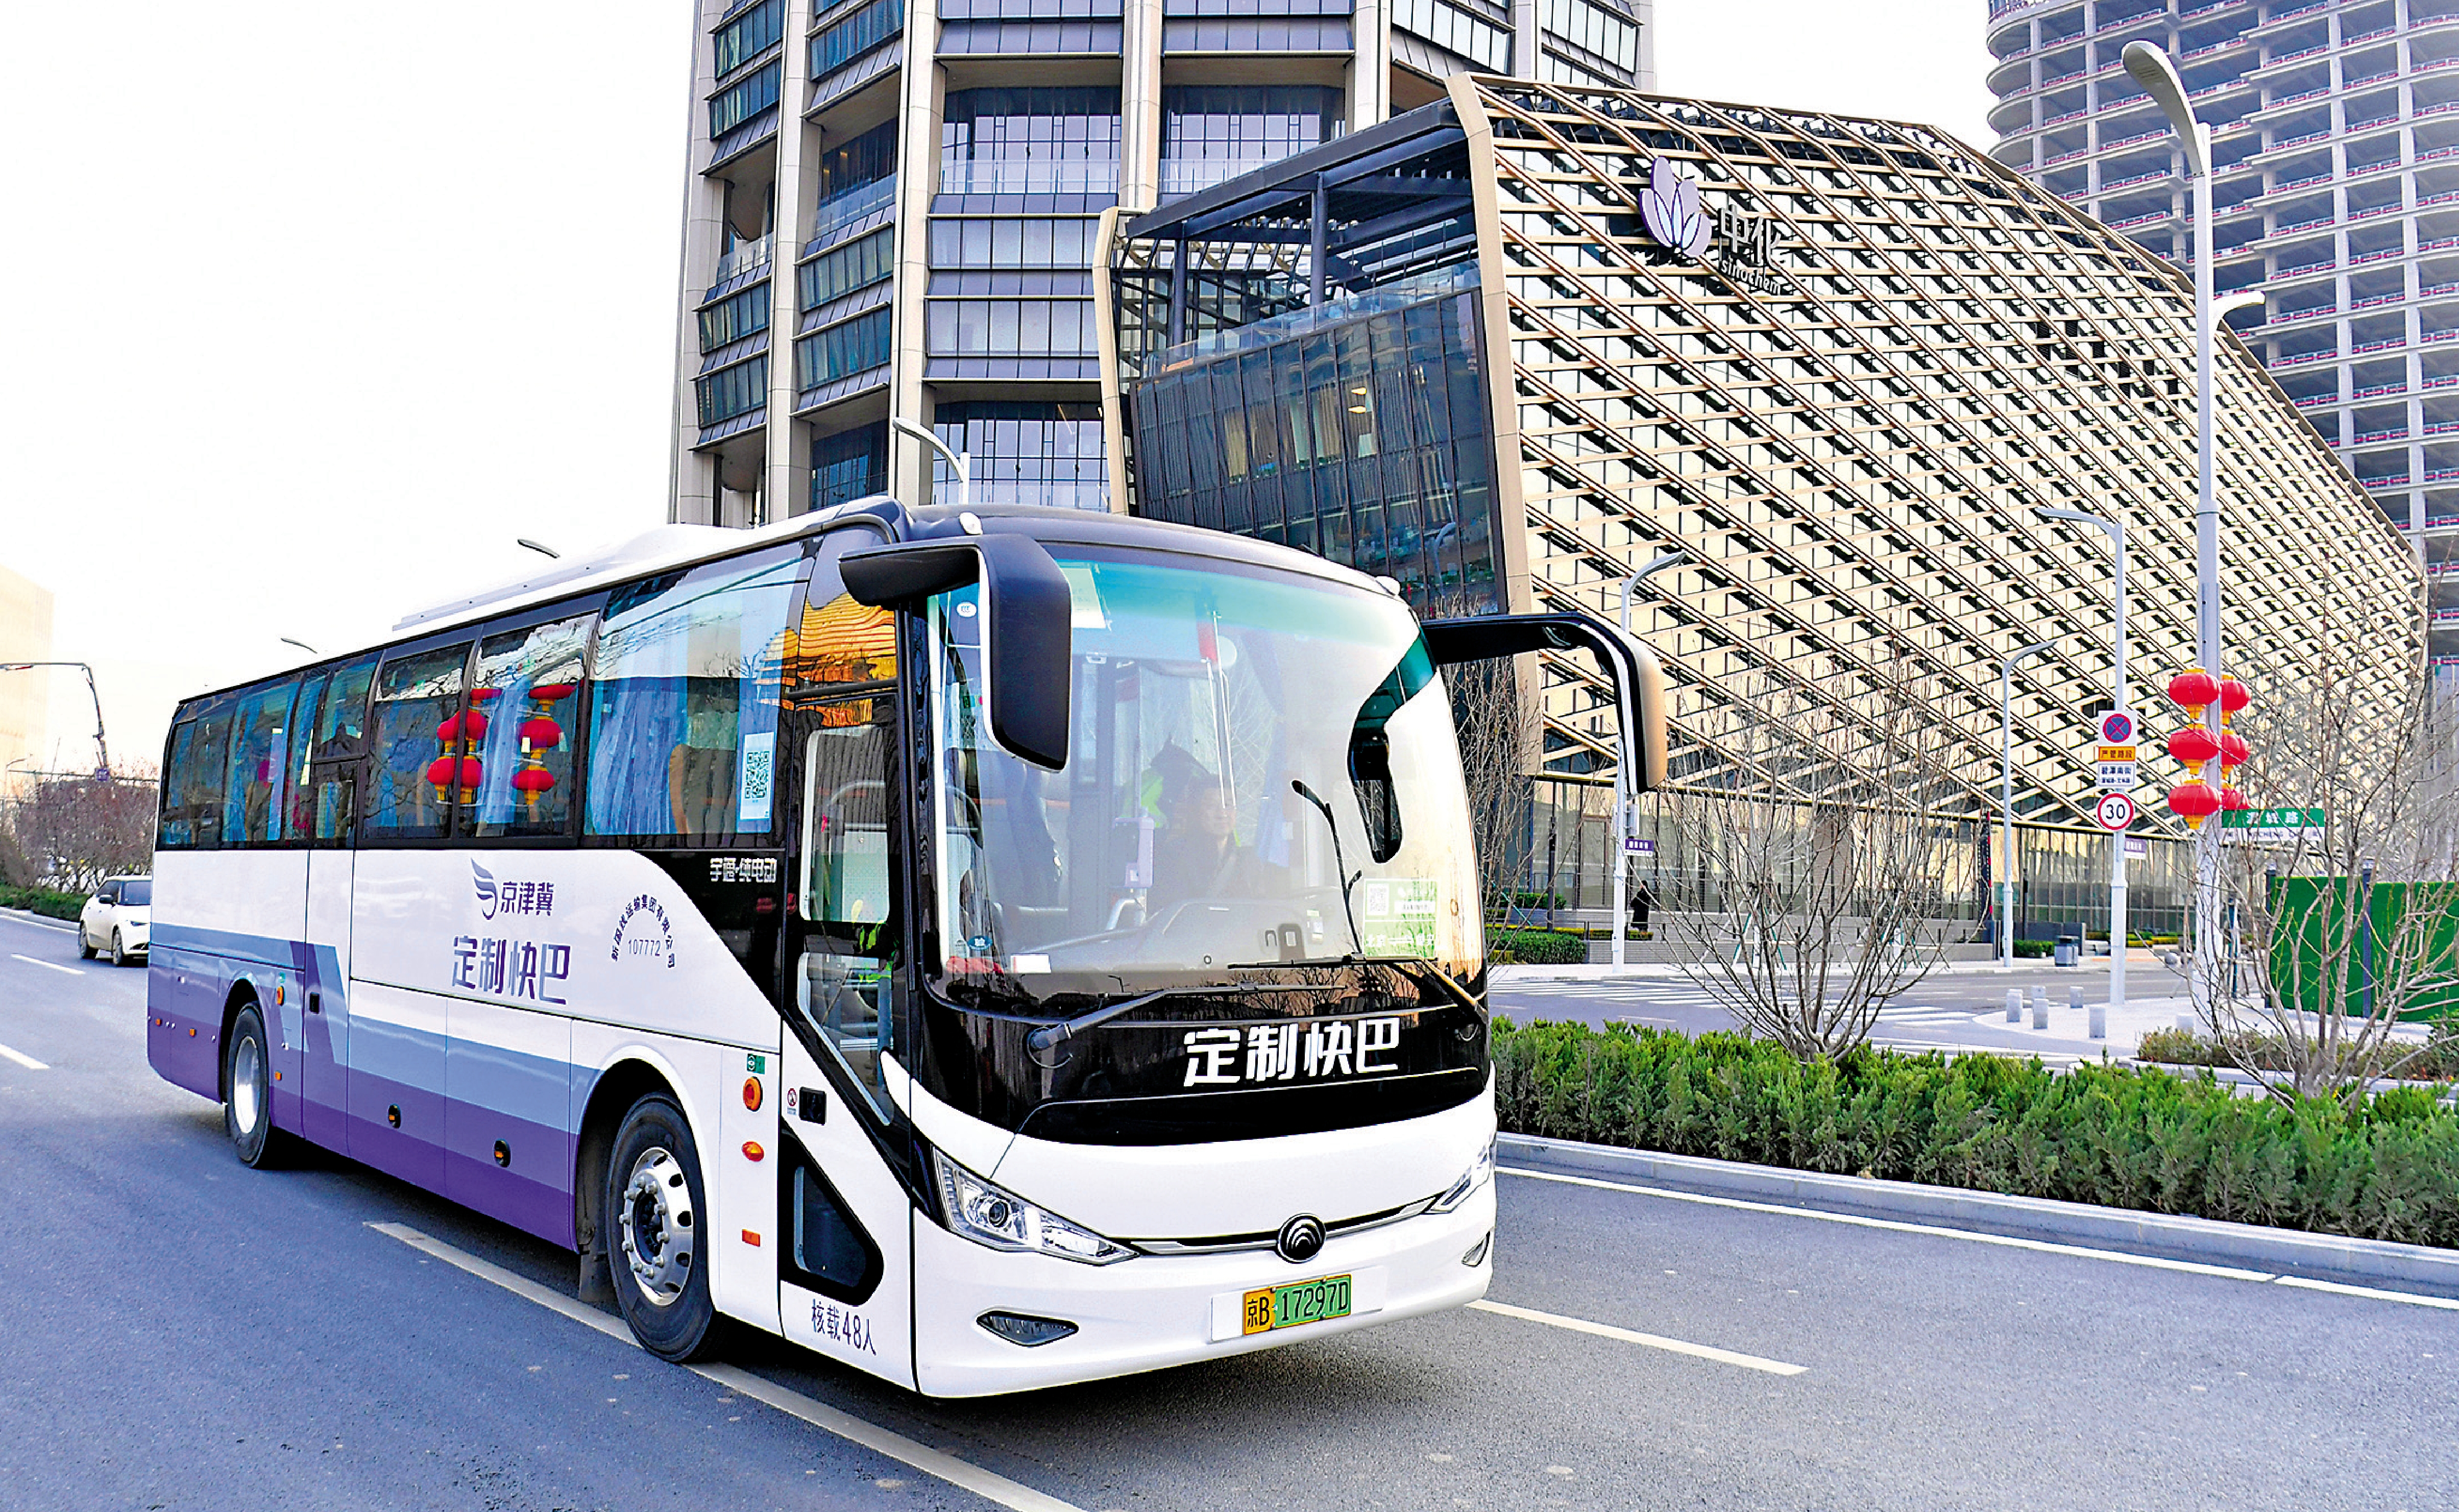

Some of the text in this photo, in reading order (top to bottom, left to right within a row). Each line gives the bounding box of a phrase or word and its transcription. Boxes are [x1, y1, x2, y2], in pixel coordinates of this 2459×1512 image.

[1719, 204, 1782, 271] 中化
[2106, 804, 2126, 819] 30
[500, 881, 554, 916] 京津冀
[451, 935, 571, 1005] 定制快巴
[628, 938, 661, 956] 107772
[1184, 1018, 1400, 1087] 定制快巴
[811, 1298, 877, 1355] 核载48人
